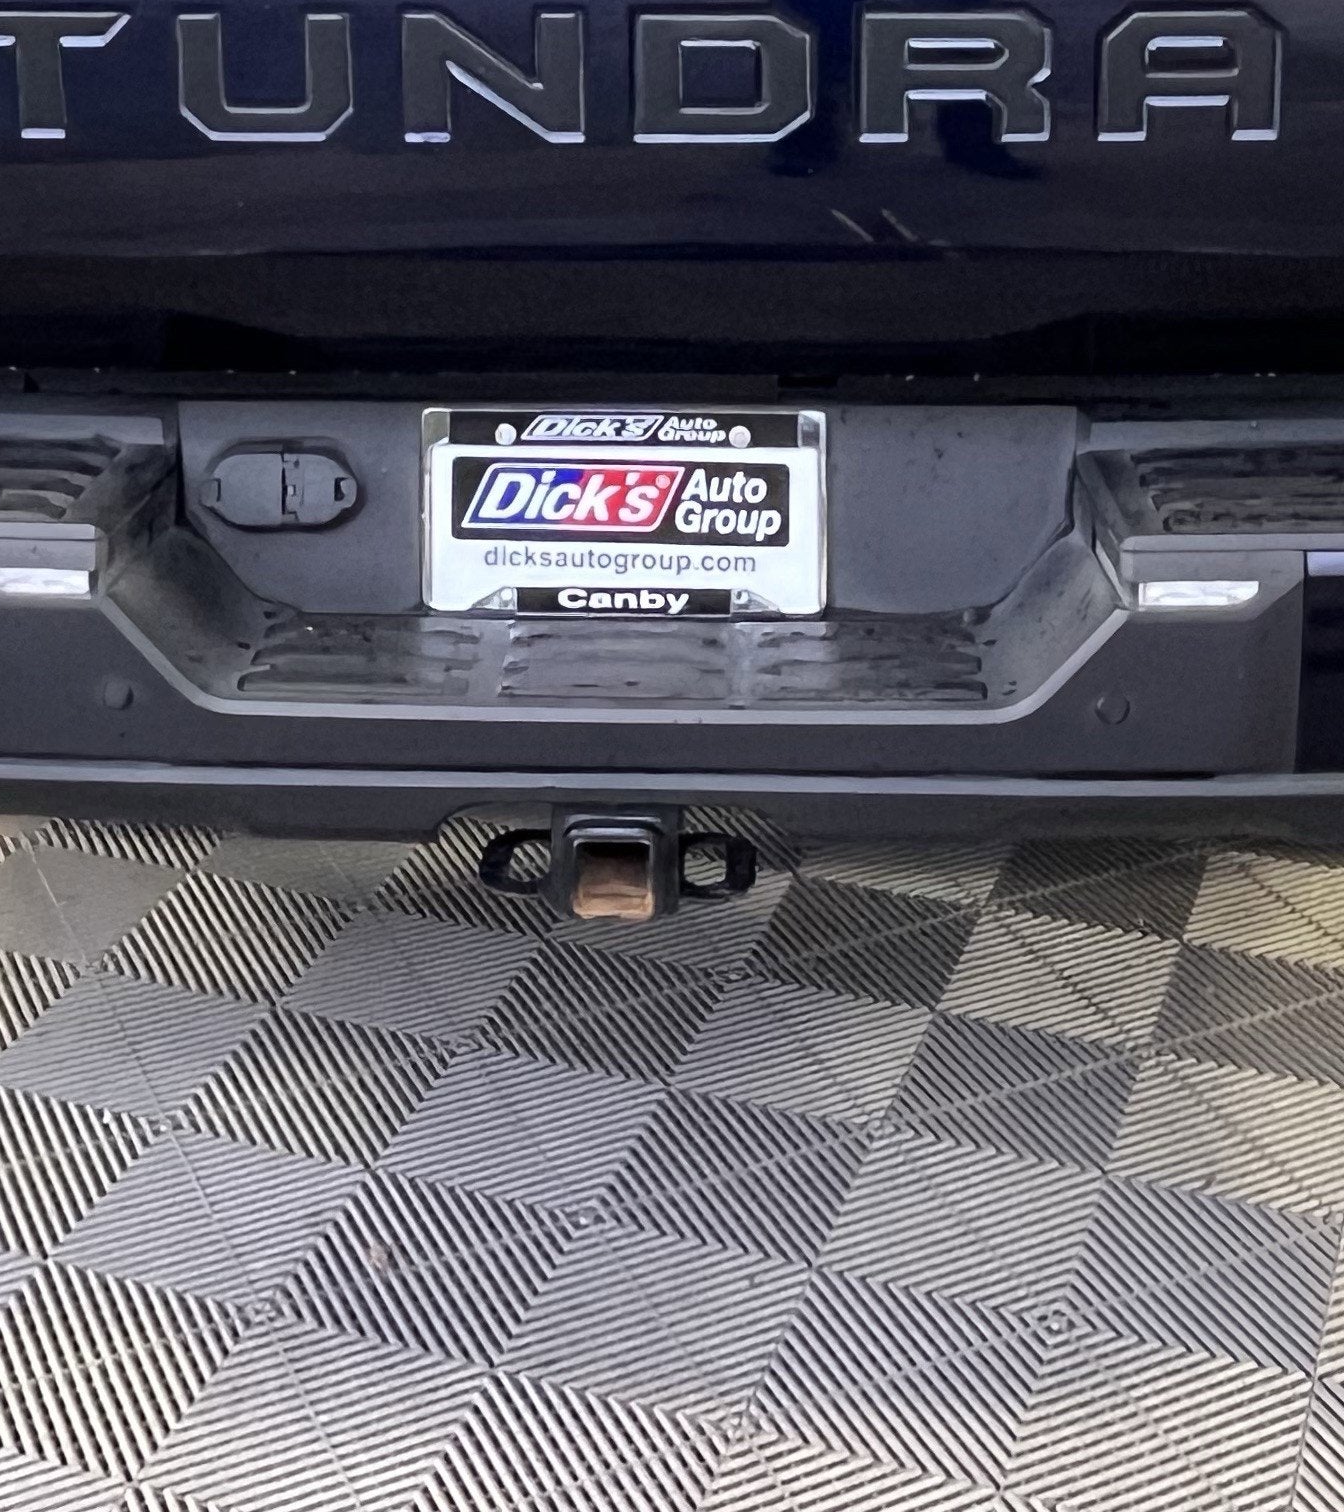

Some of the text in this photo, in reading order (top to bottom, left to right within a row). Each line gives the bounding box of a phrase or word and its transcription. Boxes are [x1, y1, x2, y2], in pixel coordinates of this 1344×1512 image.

[657, 428, 727, 443] Group
[665, 416, 718, 431] Auto
[477, 469, 660, 523] Dick's
[681, 468, 768, 503] Auto
[674, 500, 782, 541] Group
[483, 546, 757, 576] dicksautogroup.com
[557, 587, 690, 615] Canby
